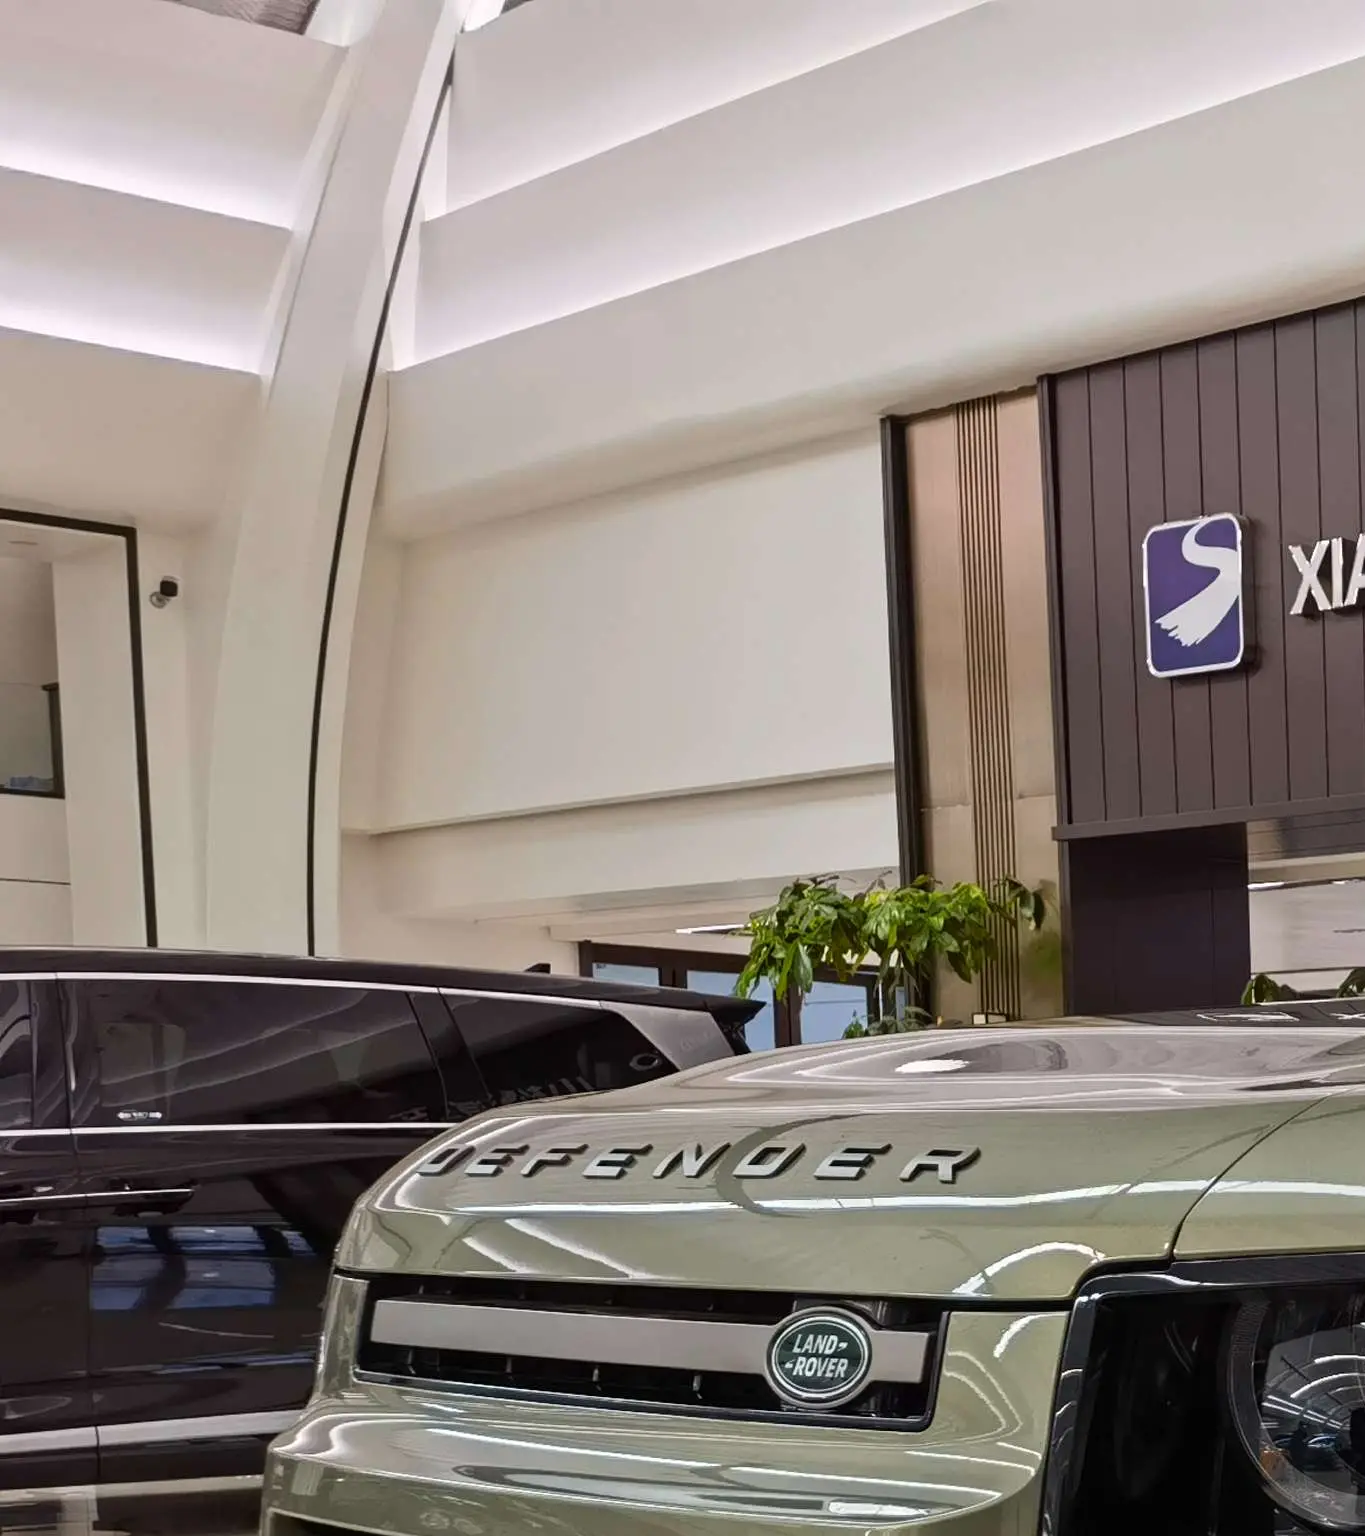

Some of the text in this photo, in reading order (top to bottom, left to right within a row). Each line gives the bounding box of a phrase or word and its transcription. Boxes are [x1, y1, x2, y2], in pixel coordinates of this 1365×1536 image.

[414, 1143, 981, 1184] DEFENDER
[792, 1333, 839, 1355] LAND
[792, 1356, 849, 1378] ROVER
